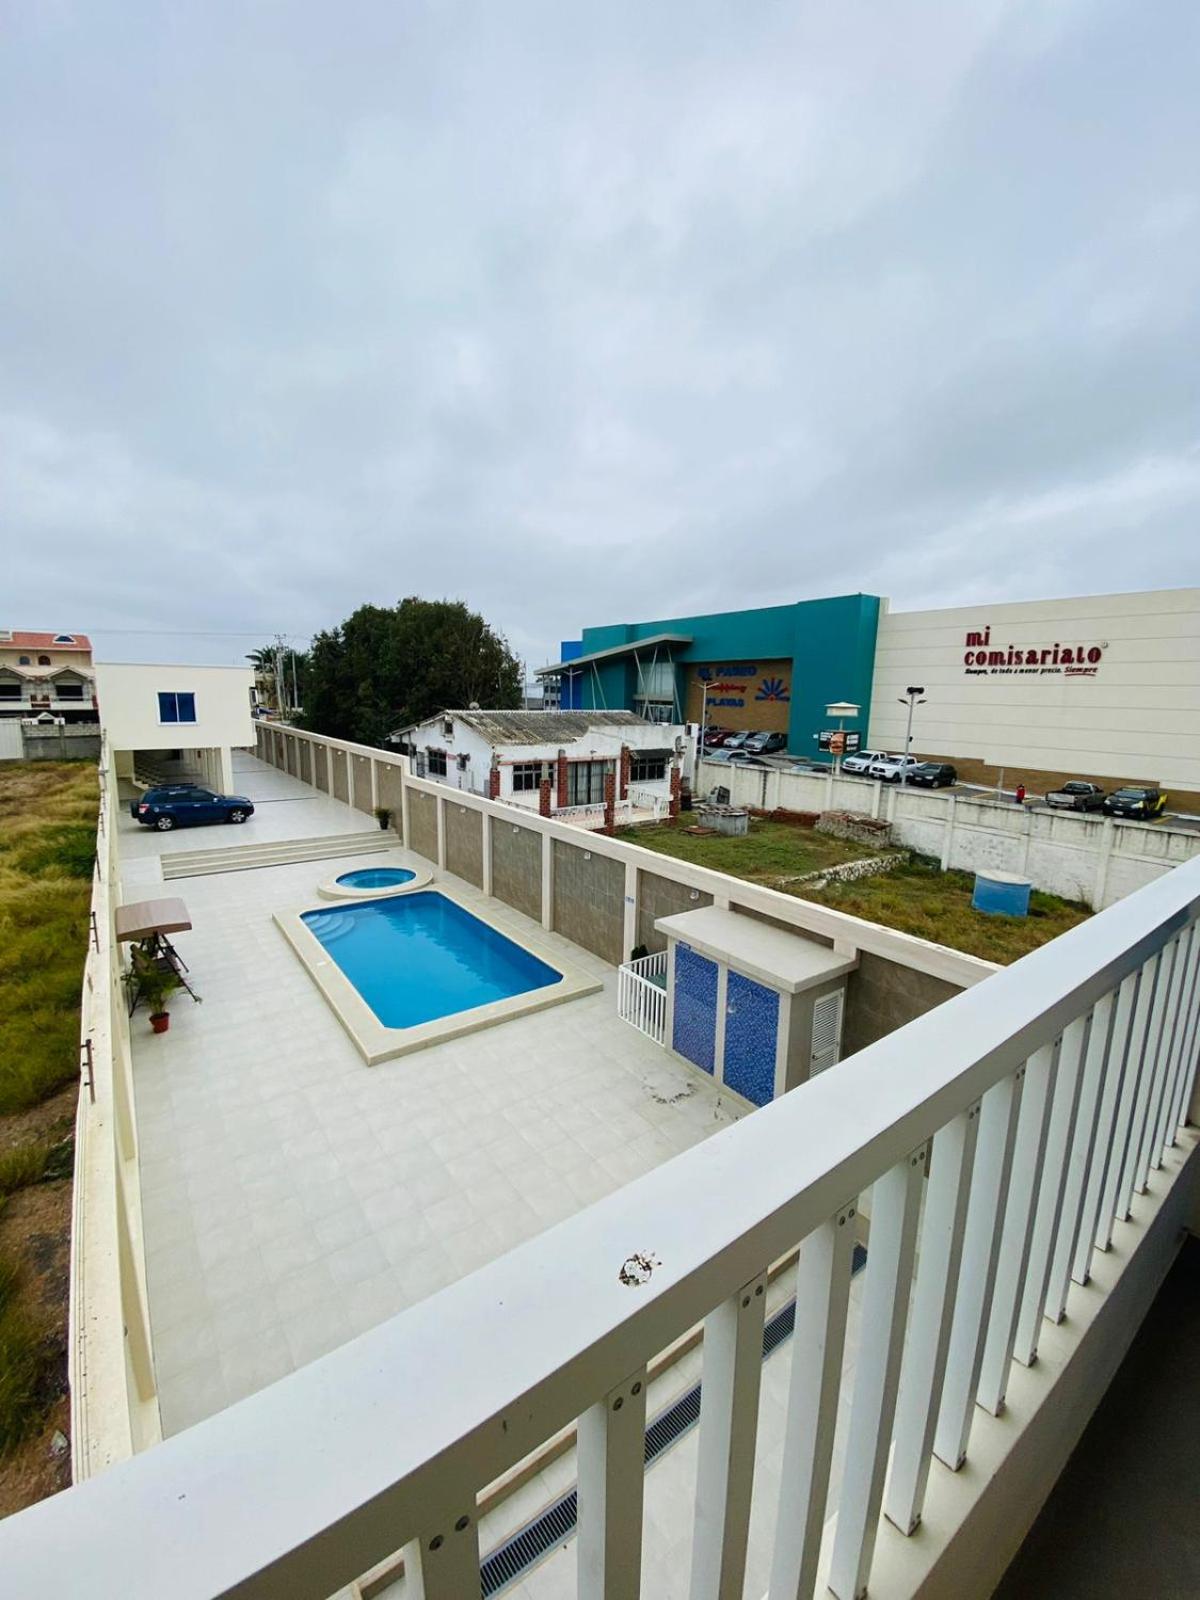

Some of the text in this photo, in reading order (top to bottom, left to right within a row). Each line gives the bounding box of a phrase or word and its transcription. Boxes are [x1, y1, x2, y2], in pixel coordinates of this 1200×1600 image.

[965, 625, 991, 647] mi
[964, 643, 1102, 666] comisariato
[1064, 666, 1098, 675] Siempre
